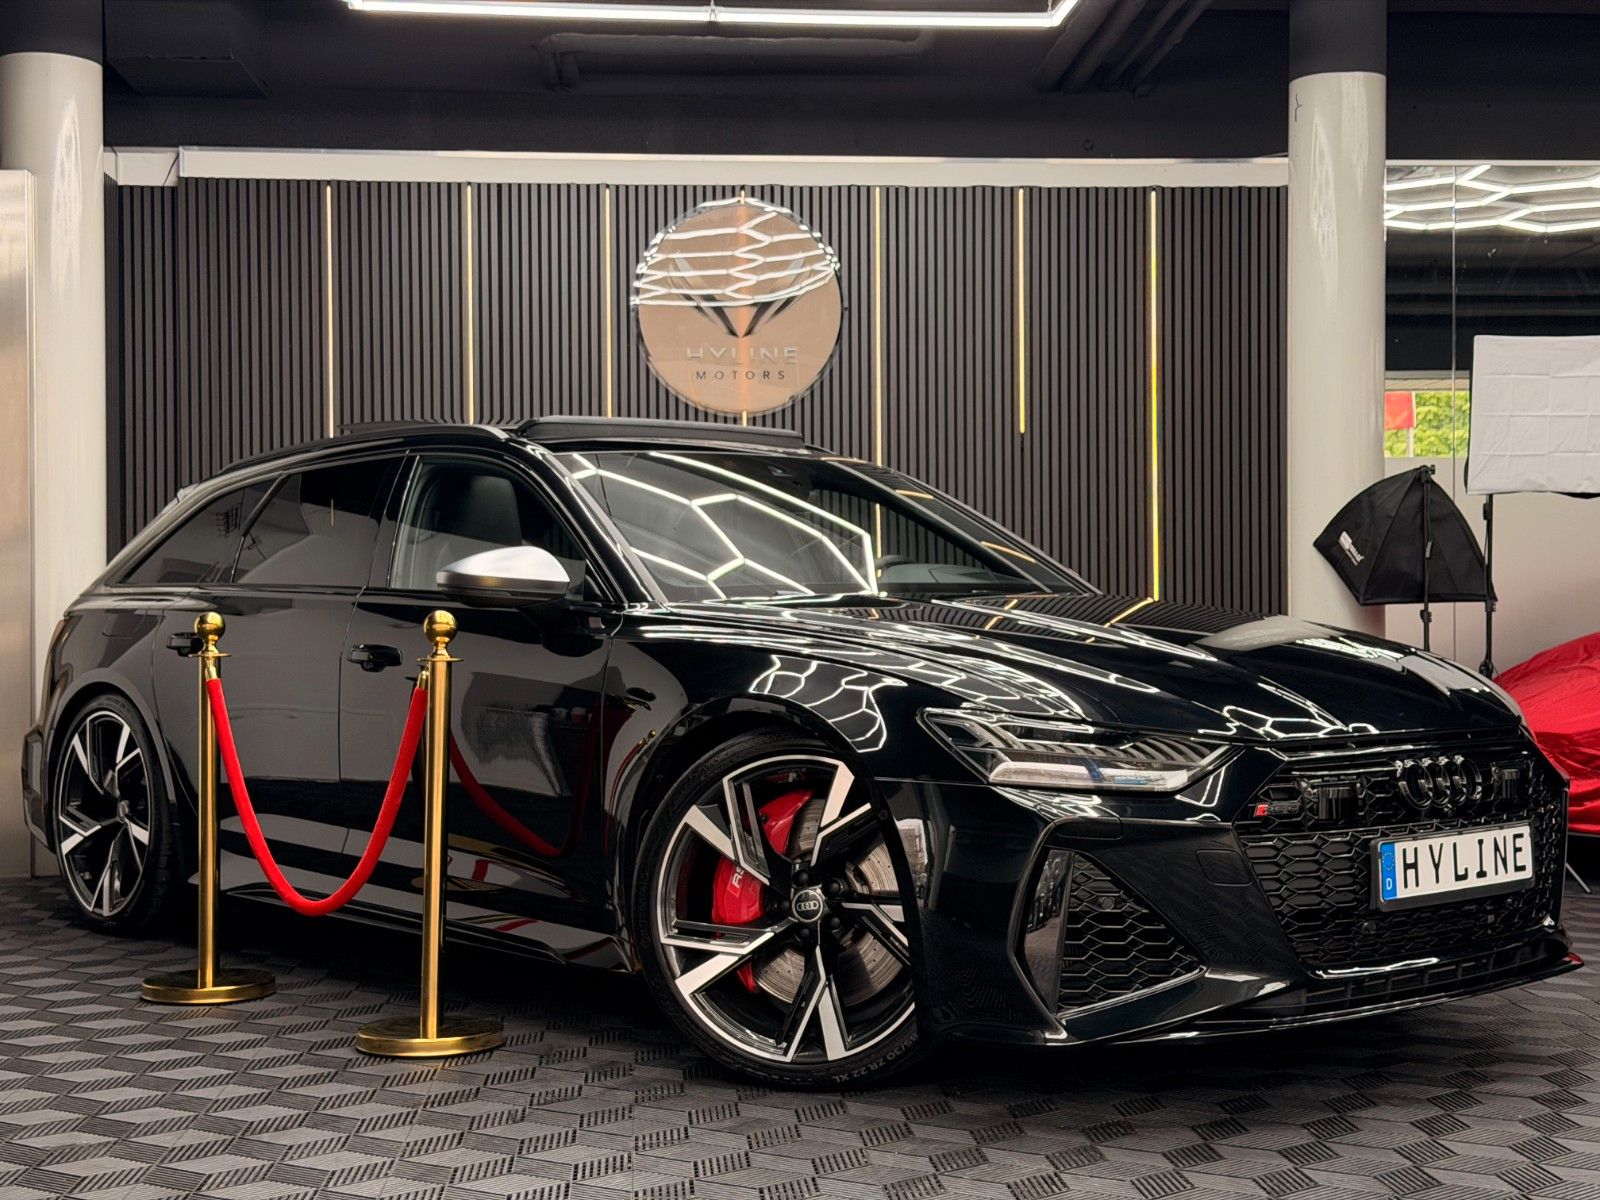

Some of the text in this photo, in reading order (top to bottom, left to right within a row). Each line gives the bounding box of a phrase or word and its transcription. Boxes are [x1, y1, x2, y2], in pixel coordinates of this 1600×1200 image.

[686, 346, 798, 364] HYLINE
[696, 370, 785, 380] MOTORS
[1402, 832, 1527, 888] HYLINE
[1386, 877, 1393, 891] D
